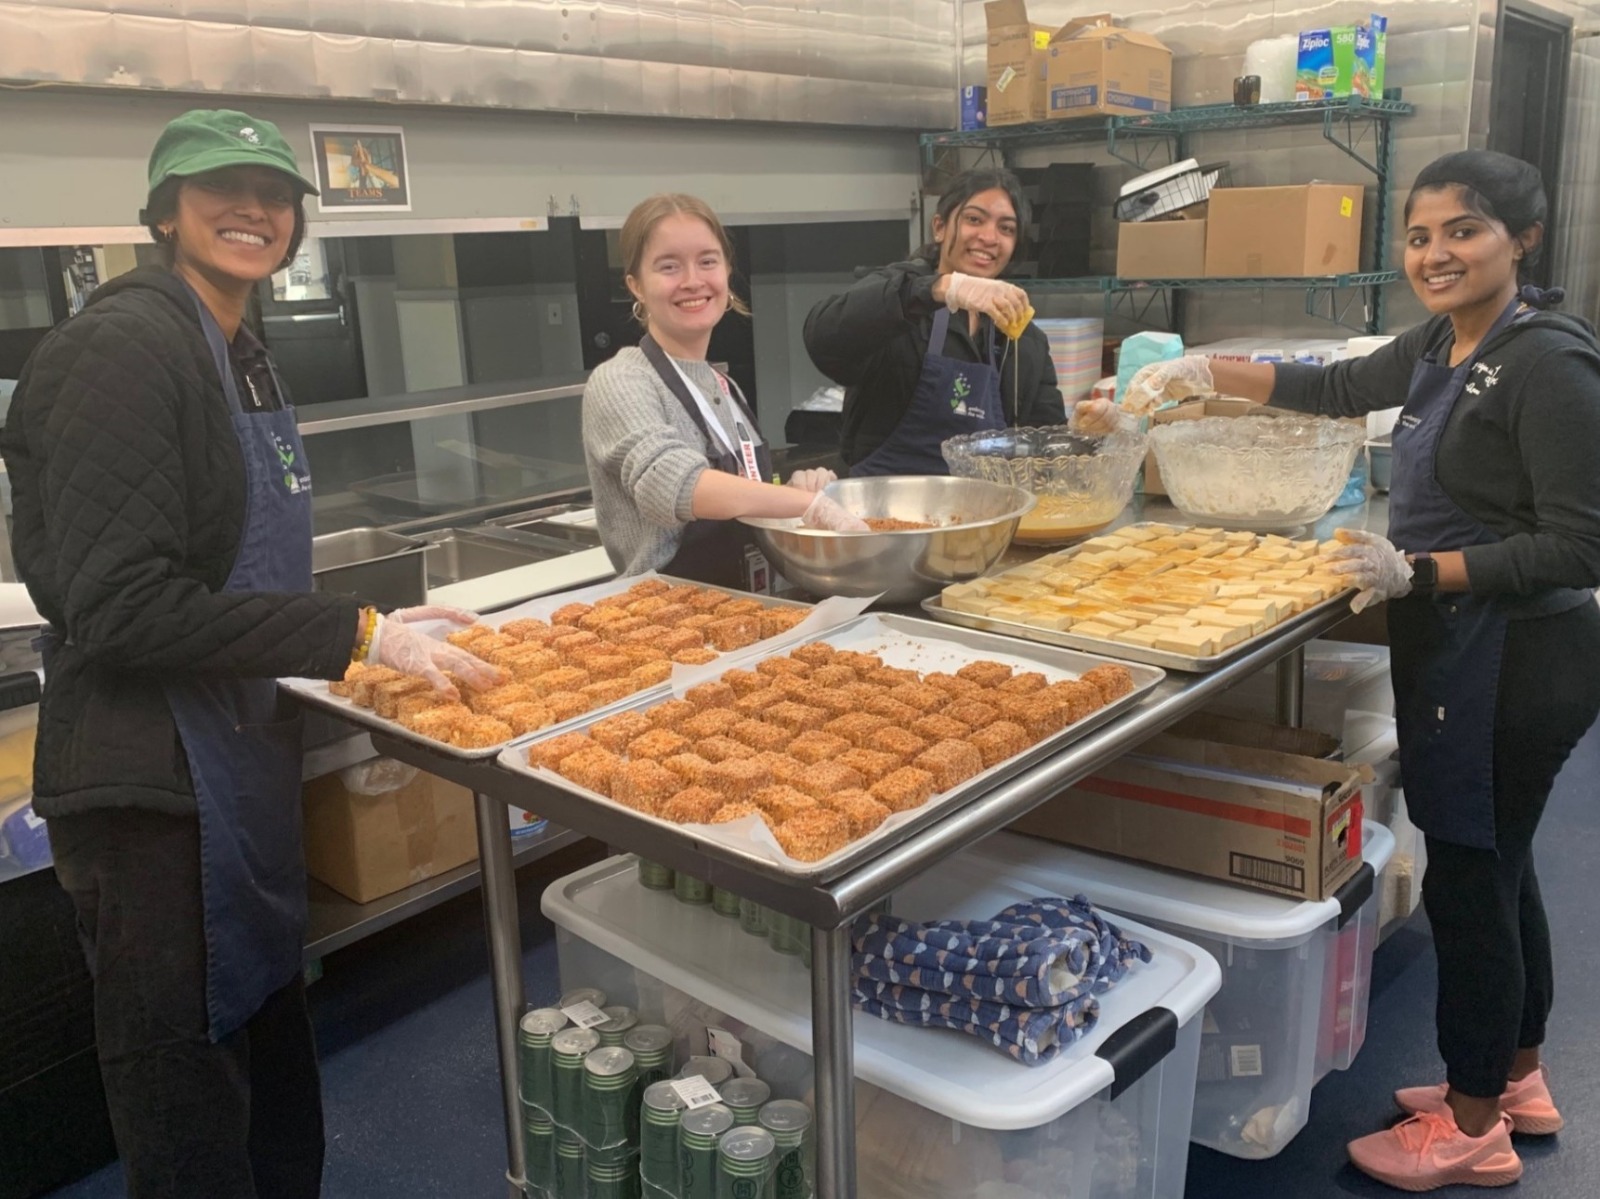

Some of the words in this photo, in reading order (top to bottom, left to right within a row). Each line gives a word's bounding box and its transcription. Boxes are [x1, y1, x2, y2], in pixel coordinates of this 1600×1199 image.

[1336, 32, 1355, 44] 580
[1303, 38, 1329, 51] Ziploc
[350, 188, 384, 198] TEAMS
